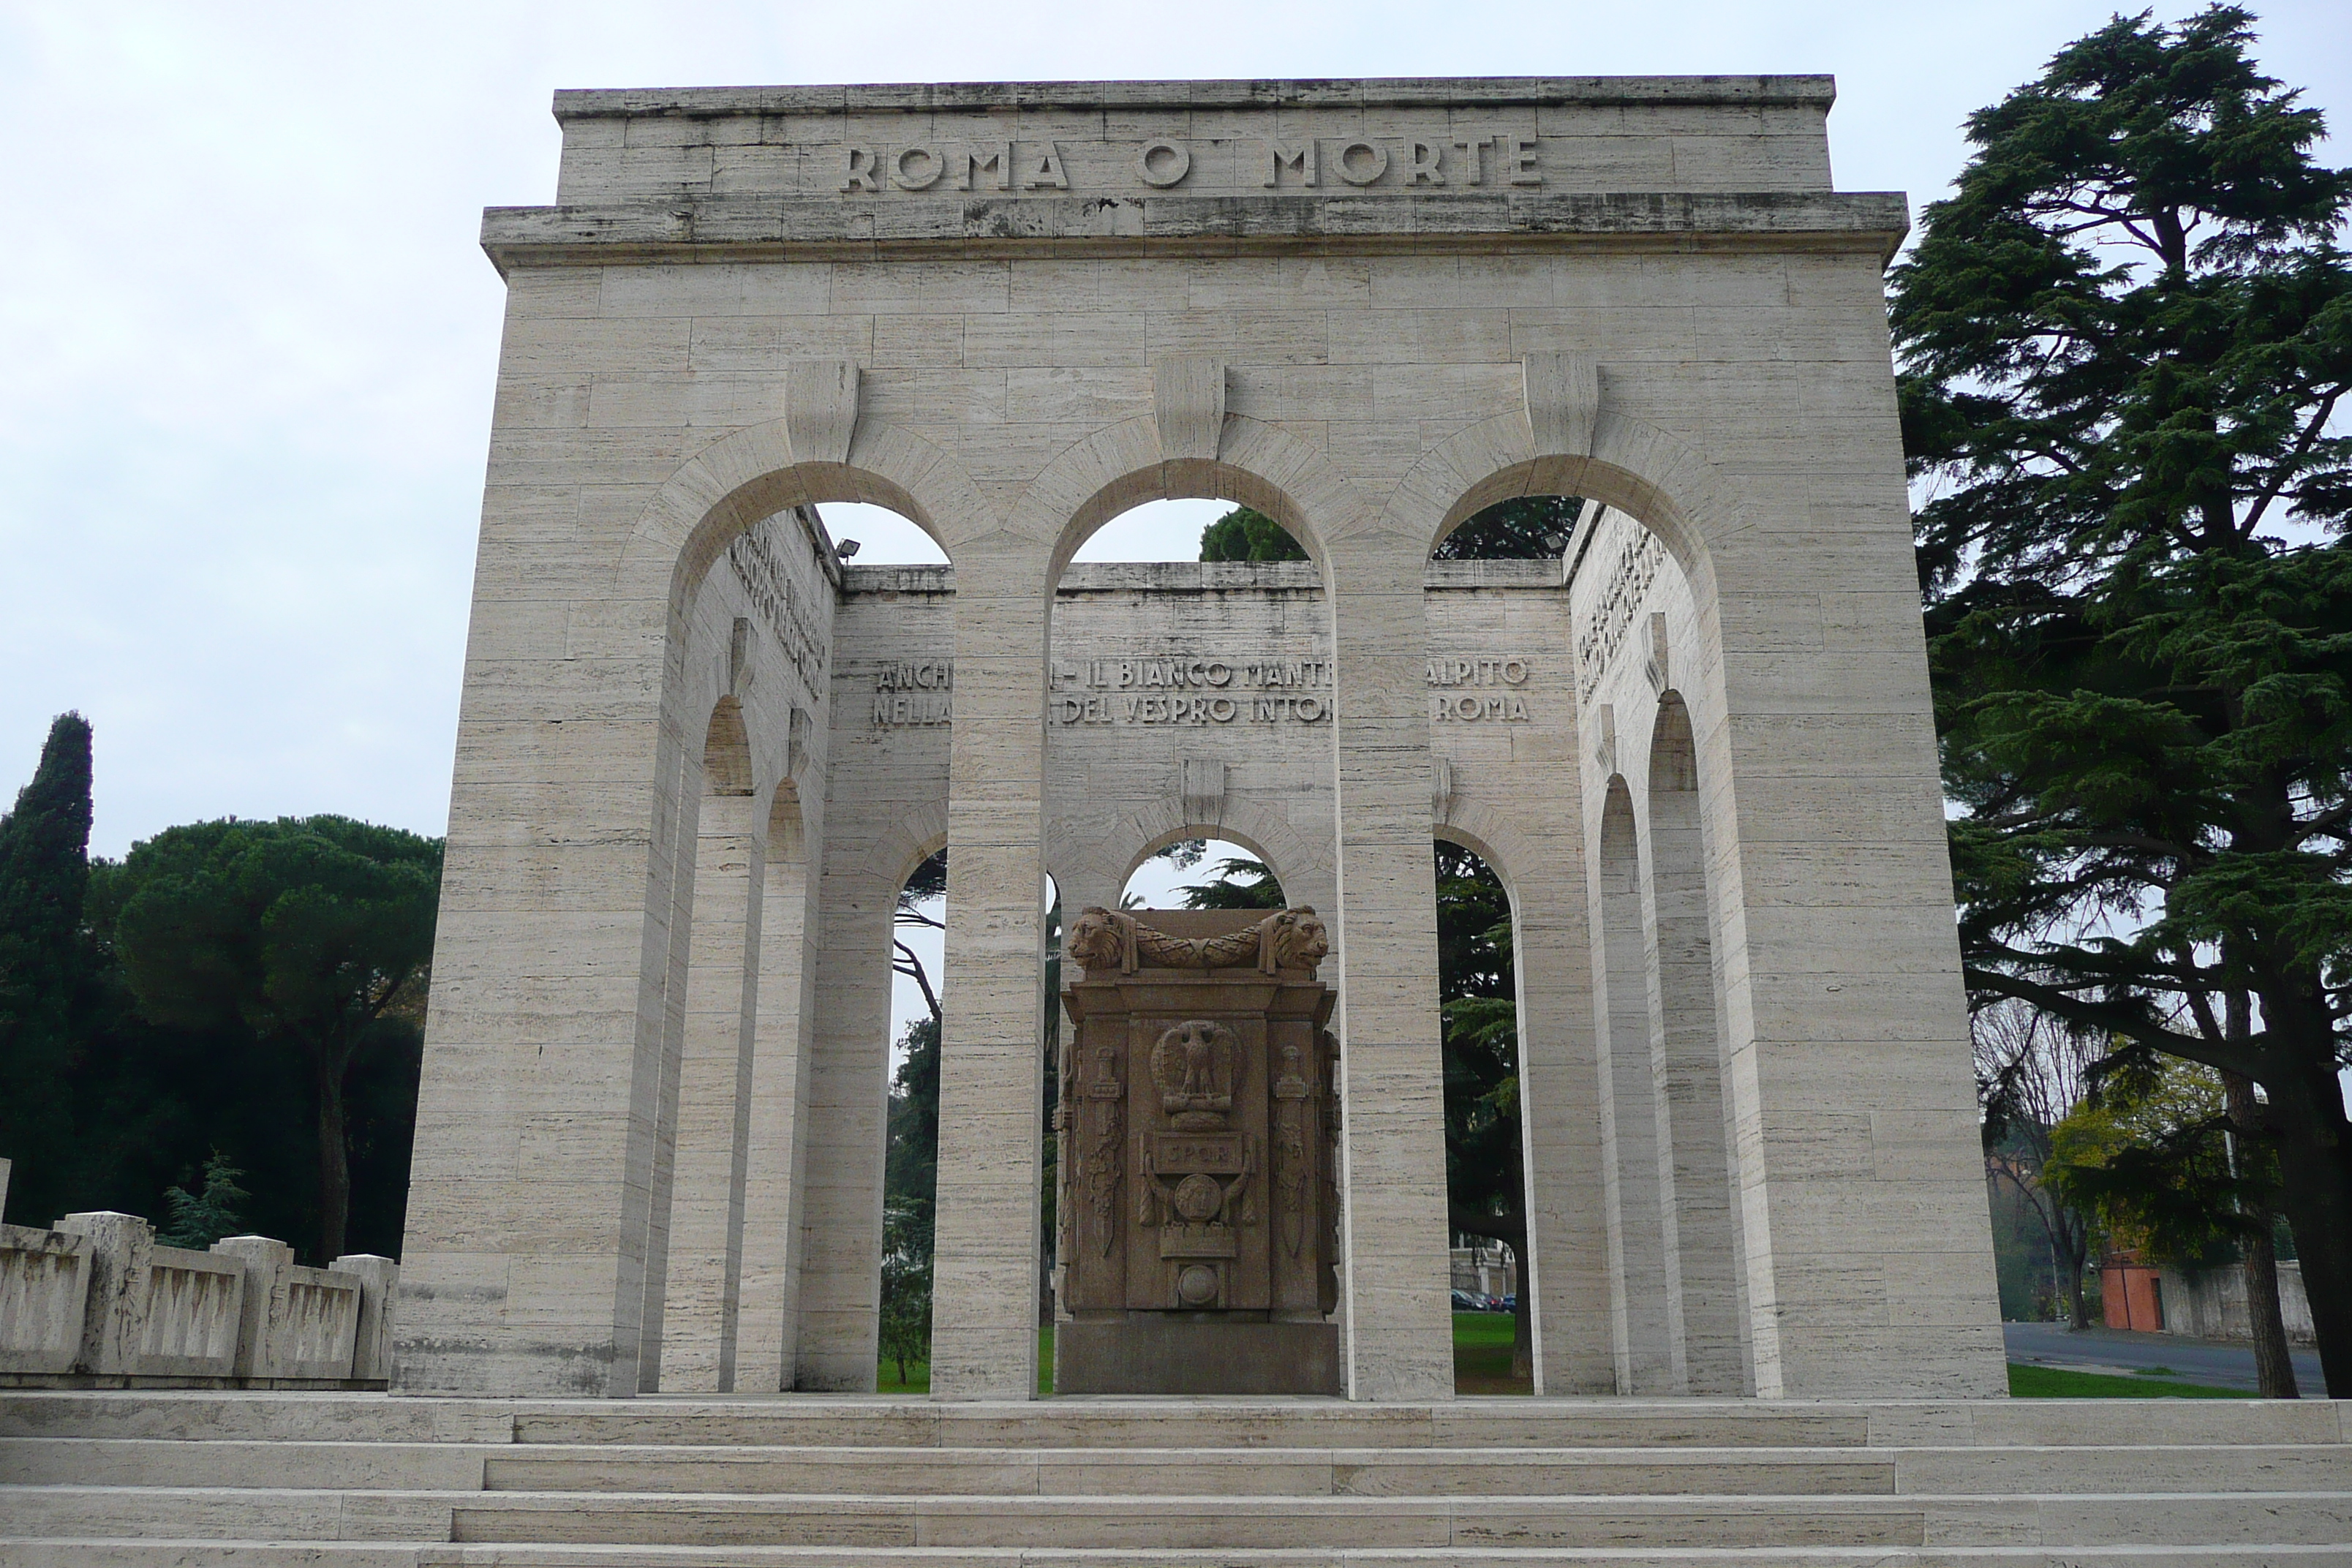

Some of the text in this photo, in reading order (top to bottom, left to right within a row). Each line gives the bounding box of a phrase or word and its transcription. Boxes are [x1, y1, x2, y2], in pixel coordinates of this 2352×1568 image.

[838, 132, 1544, 192] ROMA O MORTE
[1086, 661, 1109, 687] IL
[1118, 660, 1232, 688] BIANCO
[873, 696, 952, 724] NELLA
[1063, 698, 1113, 723] DEL
[1123, 696, 1237, 723] VESPRO
[1435, 696, 1529, 721] ROMA
